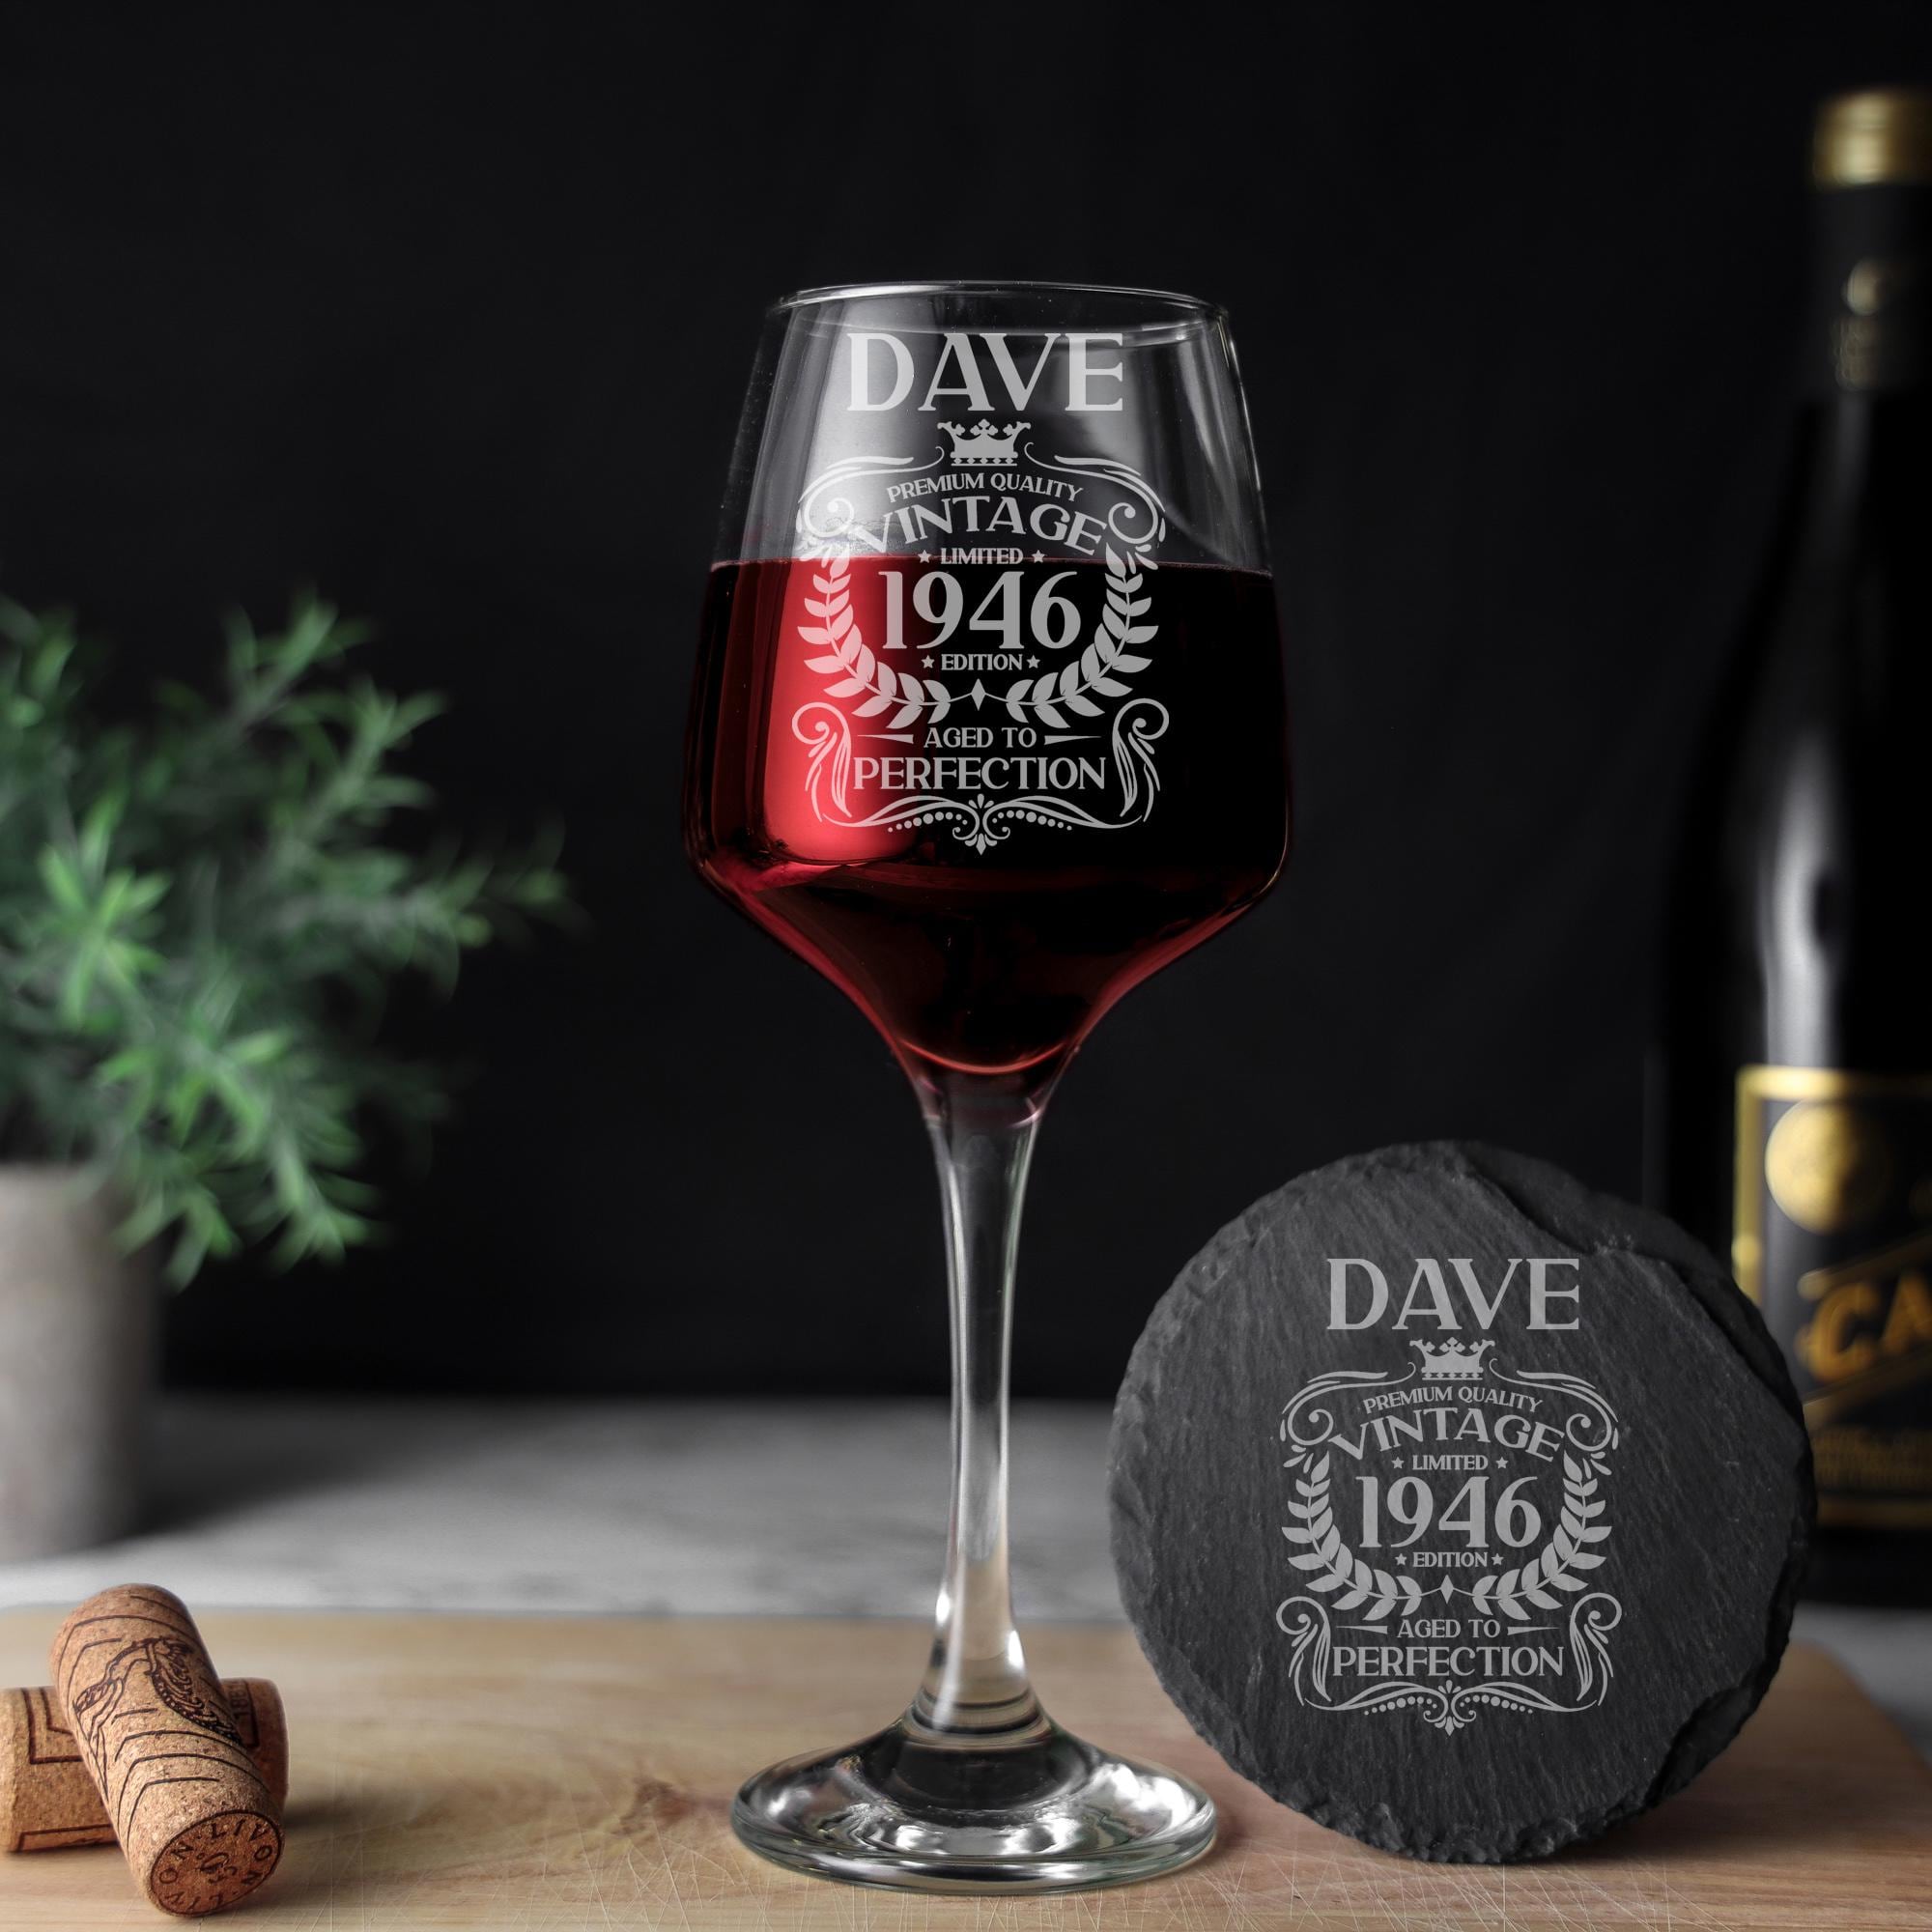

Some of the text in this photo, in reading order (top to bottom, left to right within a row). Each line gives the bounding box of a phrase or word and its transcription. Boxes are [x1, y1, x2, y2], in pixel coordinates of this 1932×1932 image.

[846, 332, 1123, 412] DAVE
[886, 472, 1084, 503] PREMIUM QUALITY
[850, 495, 1108, 556] VINTAGE
[940, 548, 1024, 565] LIMITED
[878, 571, 1082, 649] 1946
[940, 654, 1023, 671] EDITION
[923, 726, 1037, 749] AGED TO
[853, 756, 1106, 790] PERFECTION
[1327, 1258, 1579, 1329] DAVE
[1363, 1386, 1543, 1414] PREMIUM QUALITY
[1328, 1406, 1565, 1463] VINTAGE
[1412, 1455, 1489, 1470] LIMITED
[1355, 1476, 1542, 1548] 1946
[1412, 1551, 1489, 1568] EDITION
[1397, 1619, 1500, 1638] AGED TO
[1332, 1646, 1564, 1677] PERFECTION
